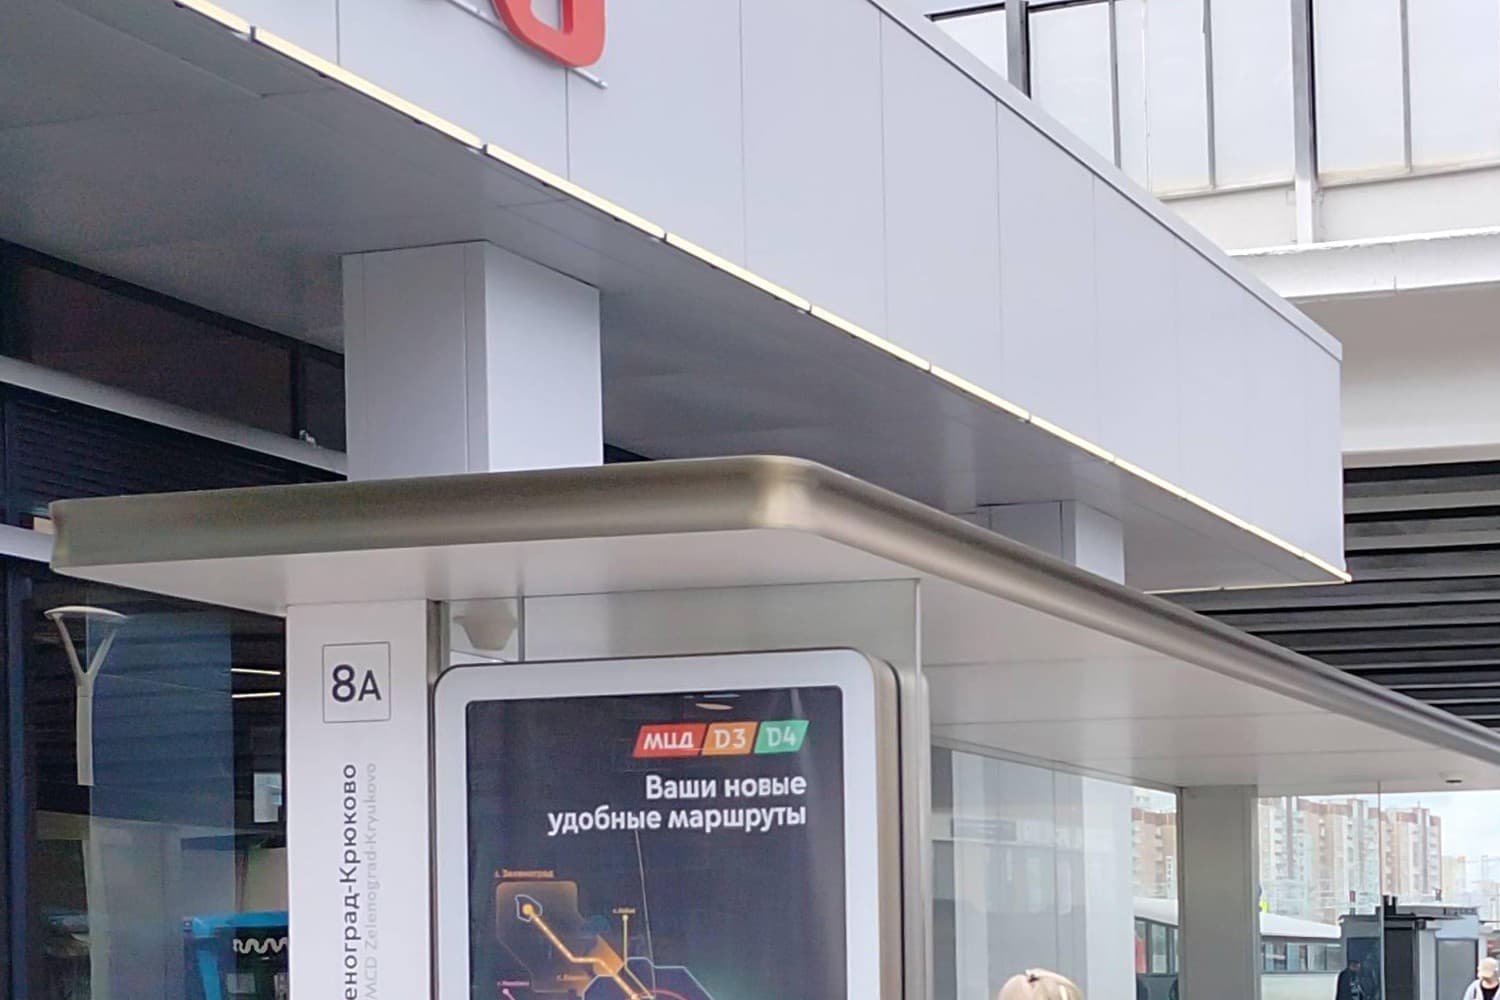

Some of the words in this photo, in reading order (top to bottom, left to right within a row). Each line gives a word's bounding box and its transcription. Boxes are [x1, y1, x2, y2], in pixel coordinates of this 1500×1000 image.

[643, 731, 694, 750] МЦД
[713, 728, 746, 749] D3
[765, 726, 797, 747] D4
[645, 774, 717, 800] Ваши
[724, 775, 808, 797] новые
[547, 804, 662, 836] удобные
[668, 805, 807, 833] маршруты
[363, 763, 380, 951] Zelenograd-Kryukovo
[364, 955, 378, 1000] MCD
